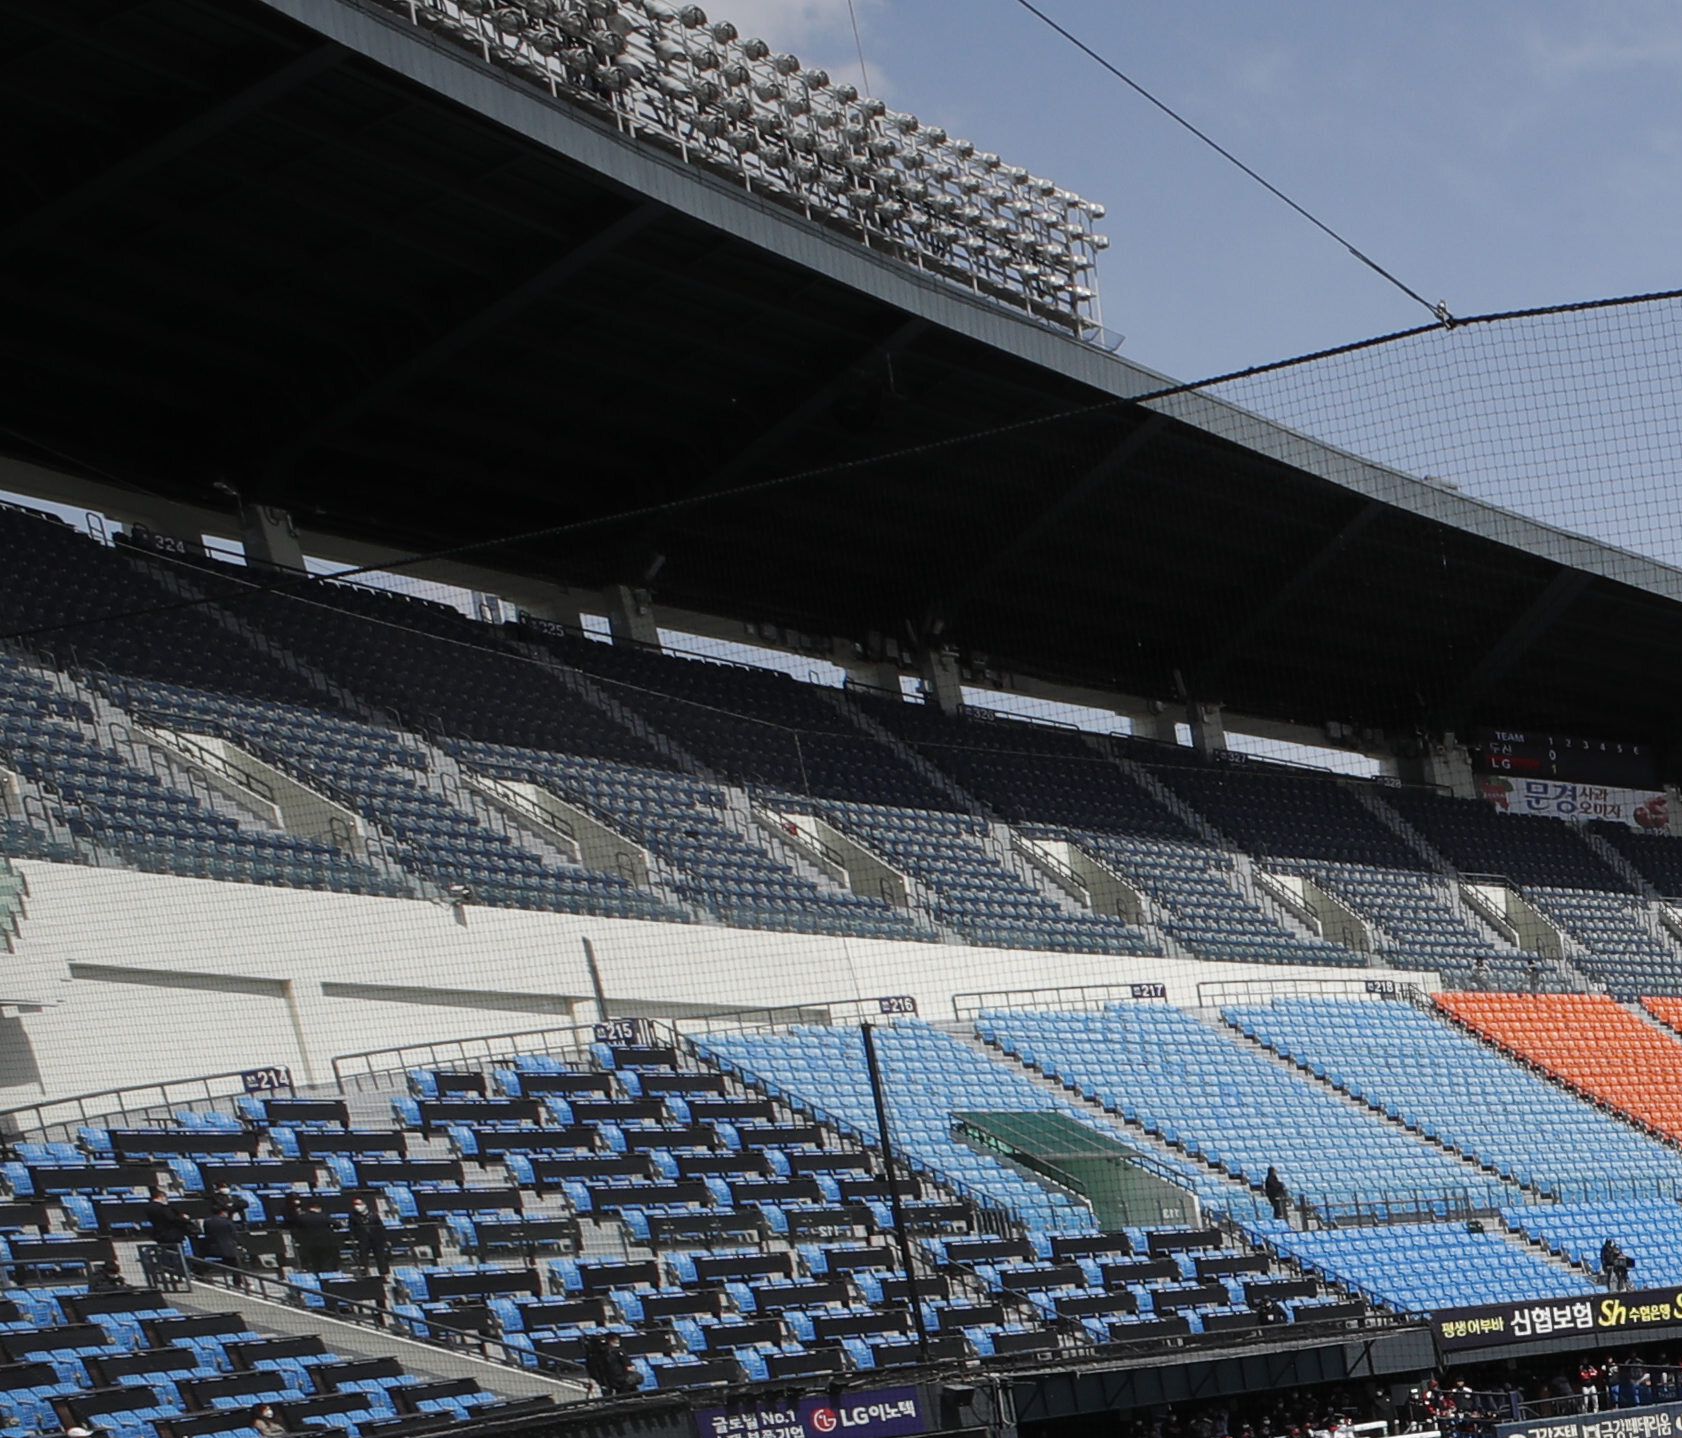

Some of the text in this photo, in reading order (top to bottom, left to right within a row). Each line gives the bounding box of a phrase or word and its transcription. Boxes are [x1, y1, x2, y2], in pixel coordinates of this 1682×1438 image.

[1495, 731, 1525, 743] TEAM
[1491, 758, 1511, 770] LG
[1525, 781, 1577, 814] 문경
[1141, 984, 1163, 998] 217
[1374, 981, 1394, 993] 218
[608, 1022, 633, 1041] 215
[257, 1069, 290, 1088] 214
[1510, 1301, 1594, 1337] 신협보험
[1598, 1299, 1627, 1328] Sh
[1629, 1302, 1671, 1323] 수협은행
[712, 1409, 796, 1433] 글로벌 No.1
[841, 1399, 916, 1428] LG이노텍
